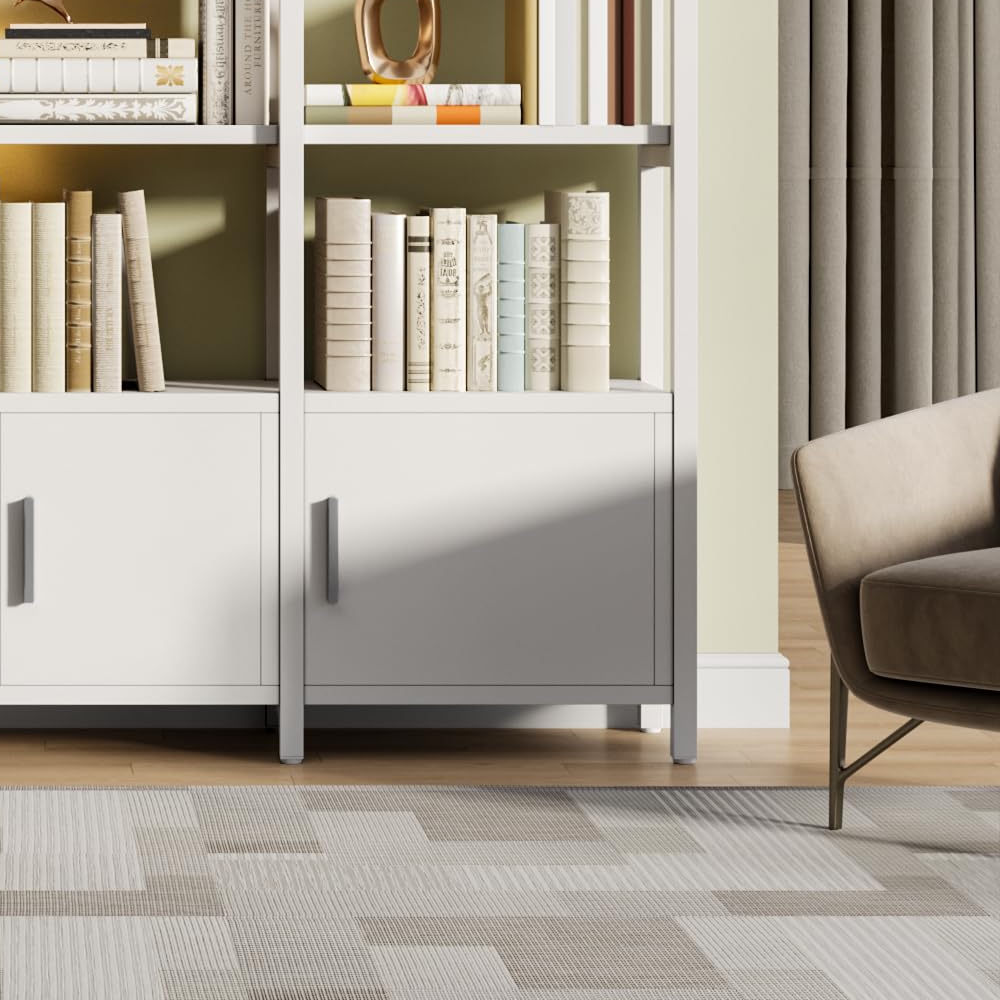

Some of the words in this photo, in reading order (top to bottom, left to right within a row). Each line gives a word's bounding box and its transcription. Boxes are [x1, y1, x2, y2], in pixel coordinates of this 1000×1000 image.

[244, 15, 252, 40] THE
[254, 0, 262, 68] FURNITURE
[244, 44, 252, 96] AROUND
